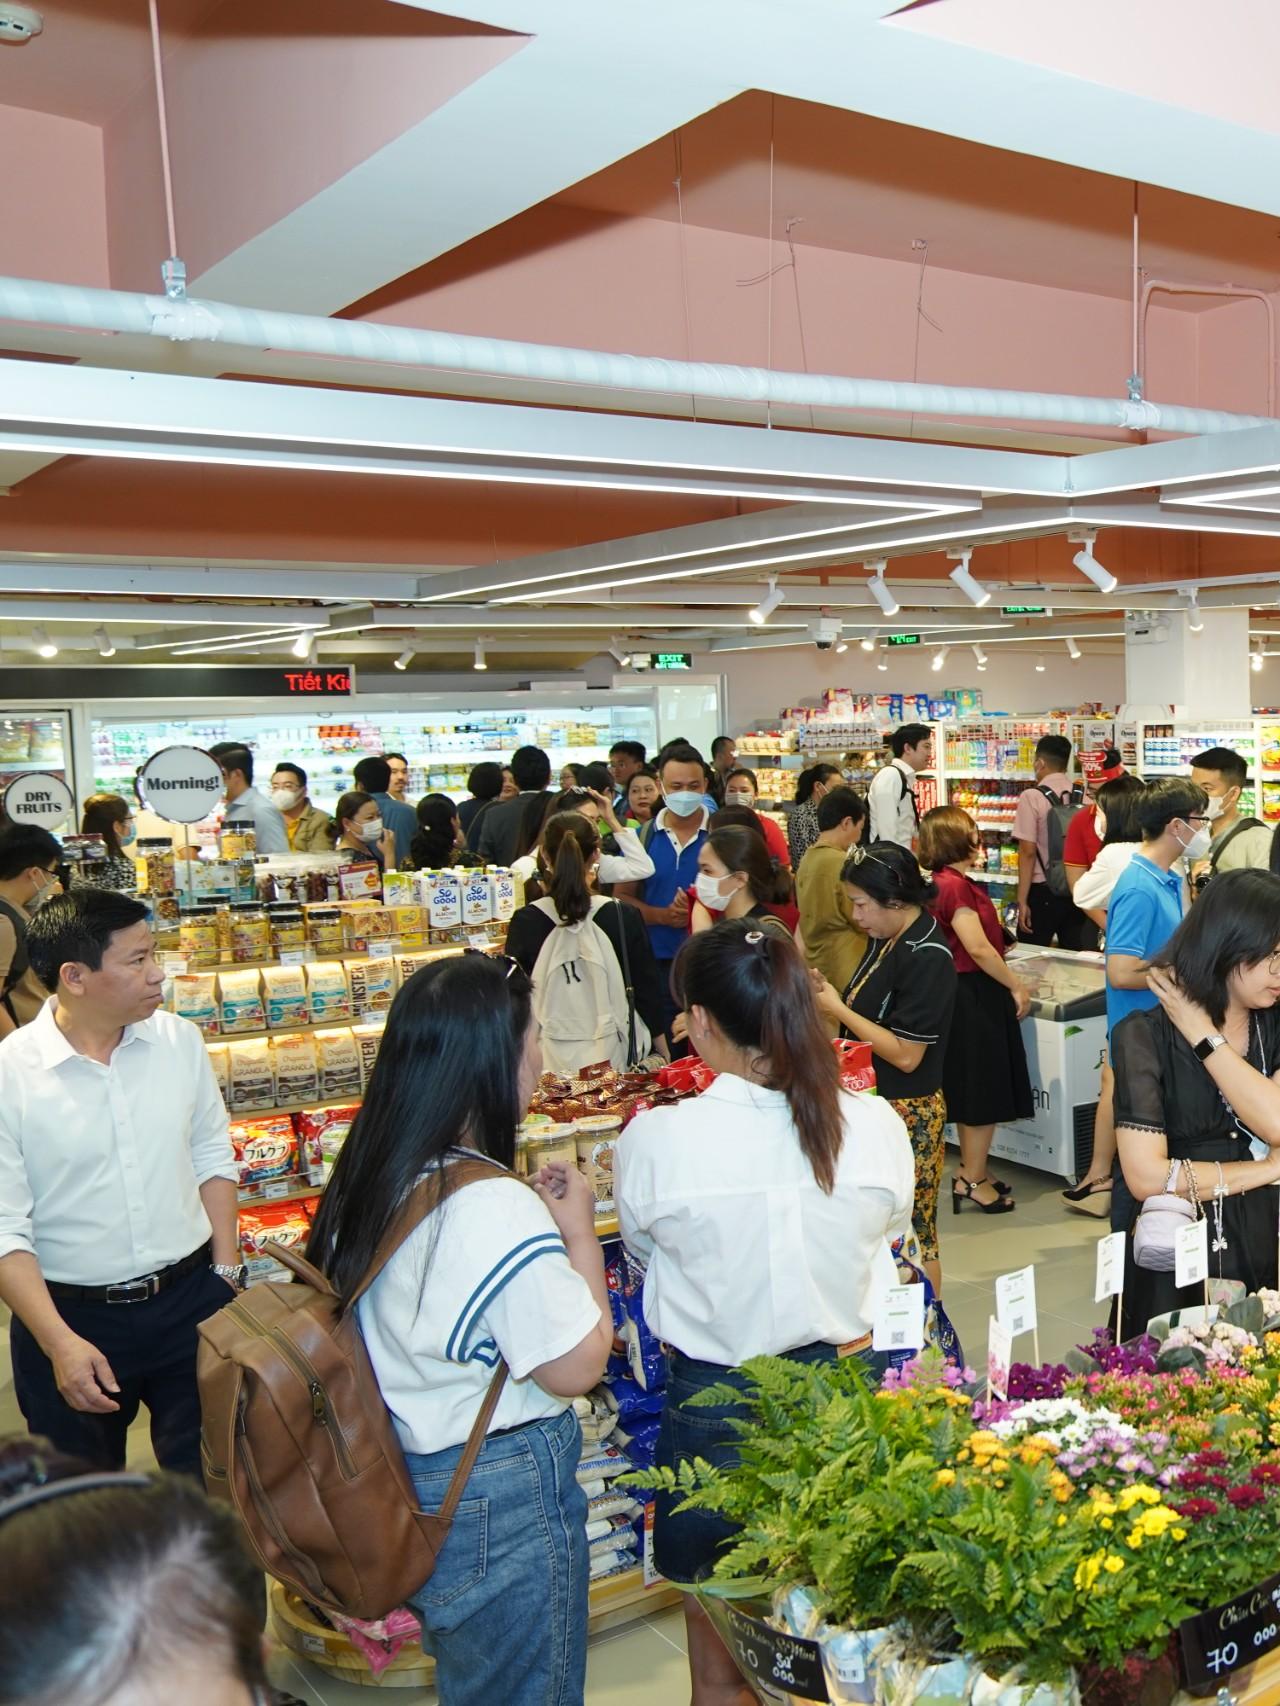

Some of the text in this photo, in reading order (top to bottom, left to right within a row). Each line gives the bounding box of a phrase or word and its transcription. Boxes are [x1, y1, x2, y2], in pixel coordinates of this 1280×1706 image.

[284, 671, 323, 691] Tiết
[147, 776, 219, 791] Morning!
[25, 791, 53, 802] DRY
[16, 802, 62, 815] FRUITS
[470, 886, 483, 895] So
[501, 882, 510, 890] So
[439, 888, 452, 898] So
[466, 893, 487, 902] Good
[498, 889, 513, 898] Good
[433, 896, 457, 905] Good
[736, 1639, 759, 1668] 70
[1206, 1623, 1277, 1674] 70 000
[772, 1666, 795, 1684] 000
